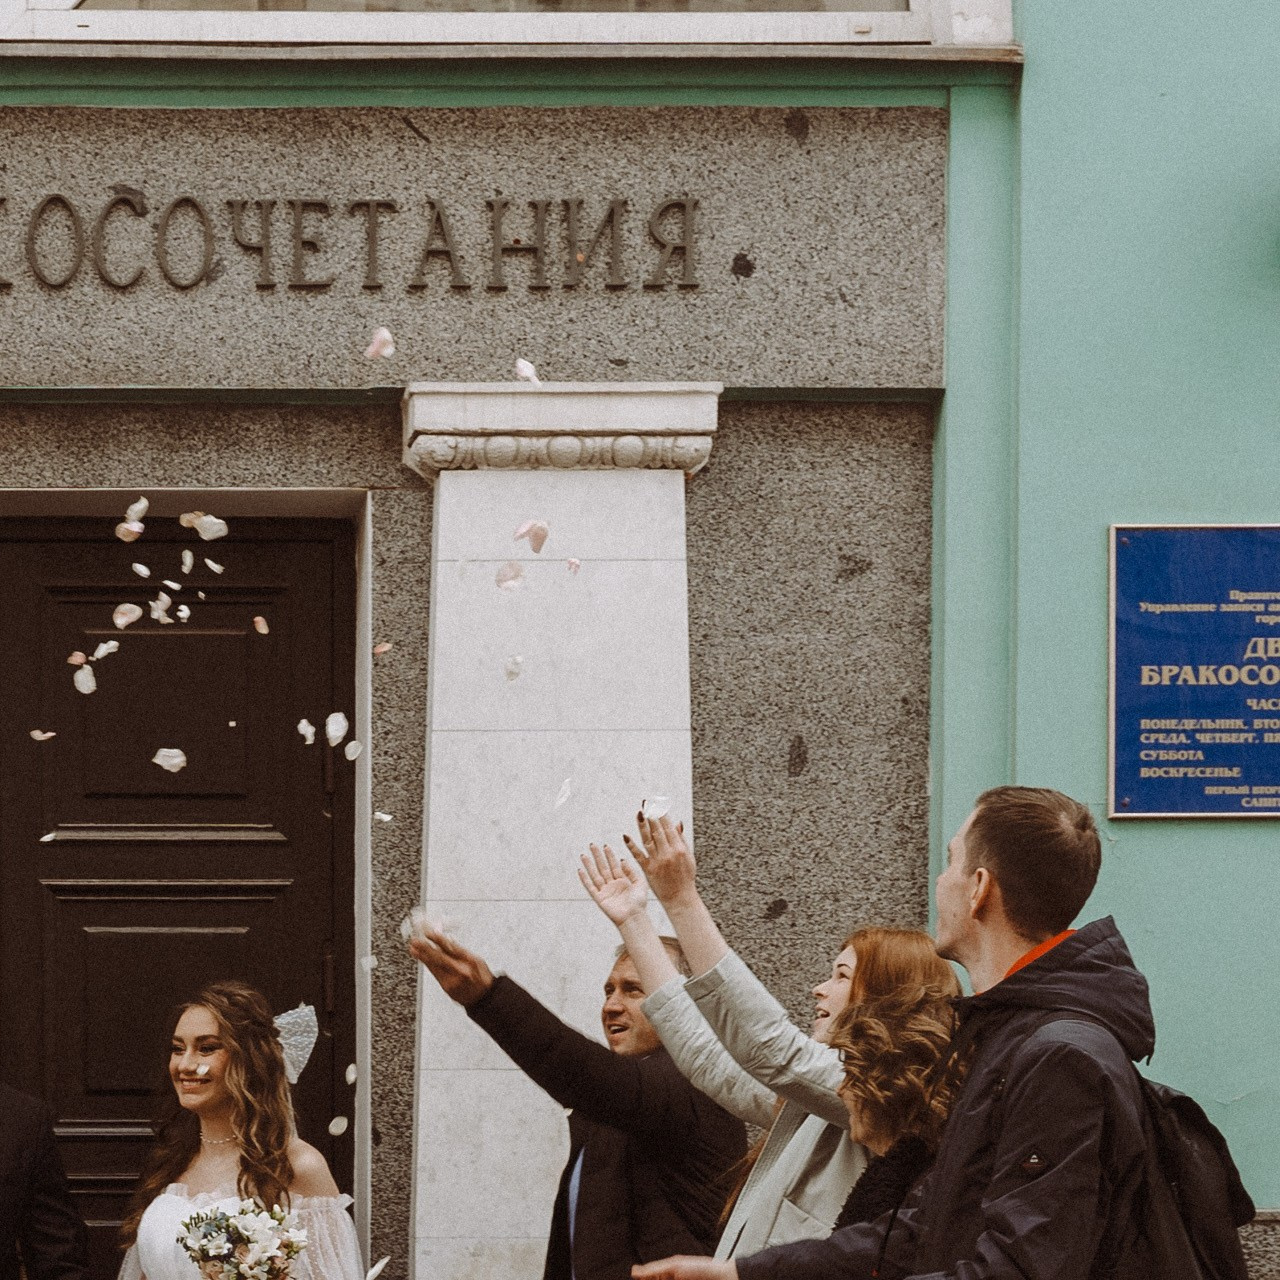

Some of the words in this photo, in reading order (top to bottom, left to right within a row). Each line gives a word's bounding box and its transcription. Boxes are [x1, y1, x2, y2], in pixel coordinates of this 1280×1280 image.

[1243, 637, 1280, 661] ДВ
[1141, 664, 1280, 685] БРАКОСО
[1246, 699, 1280, 710] ЧАС
[1140, 750, 1205, 760] СУББОТА
[1140, 767, 1242, 778] ВОСКРЕСЕНЬЕ
